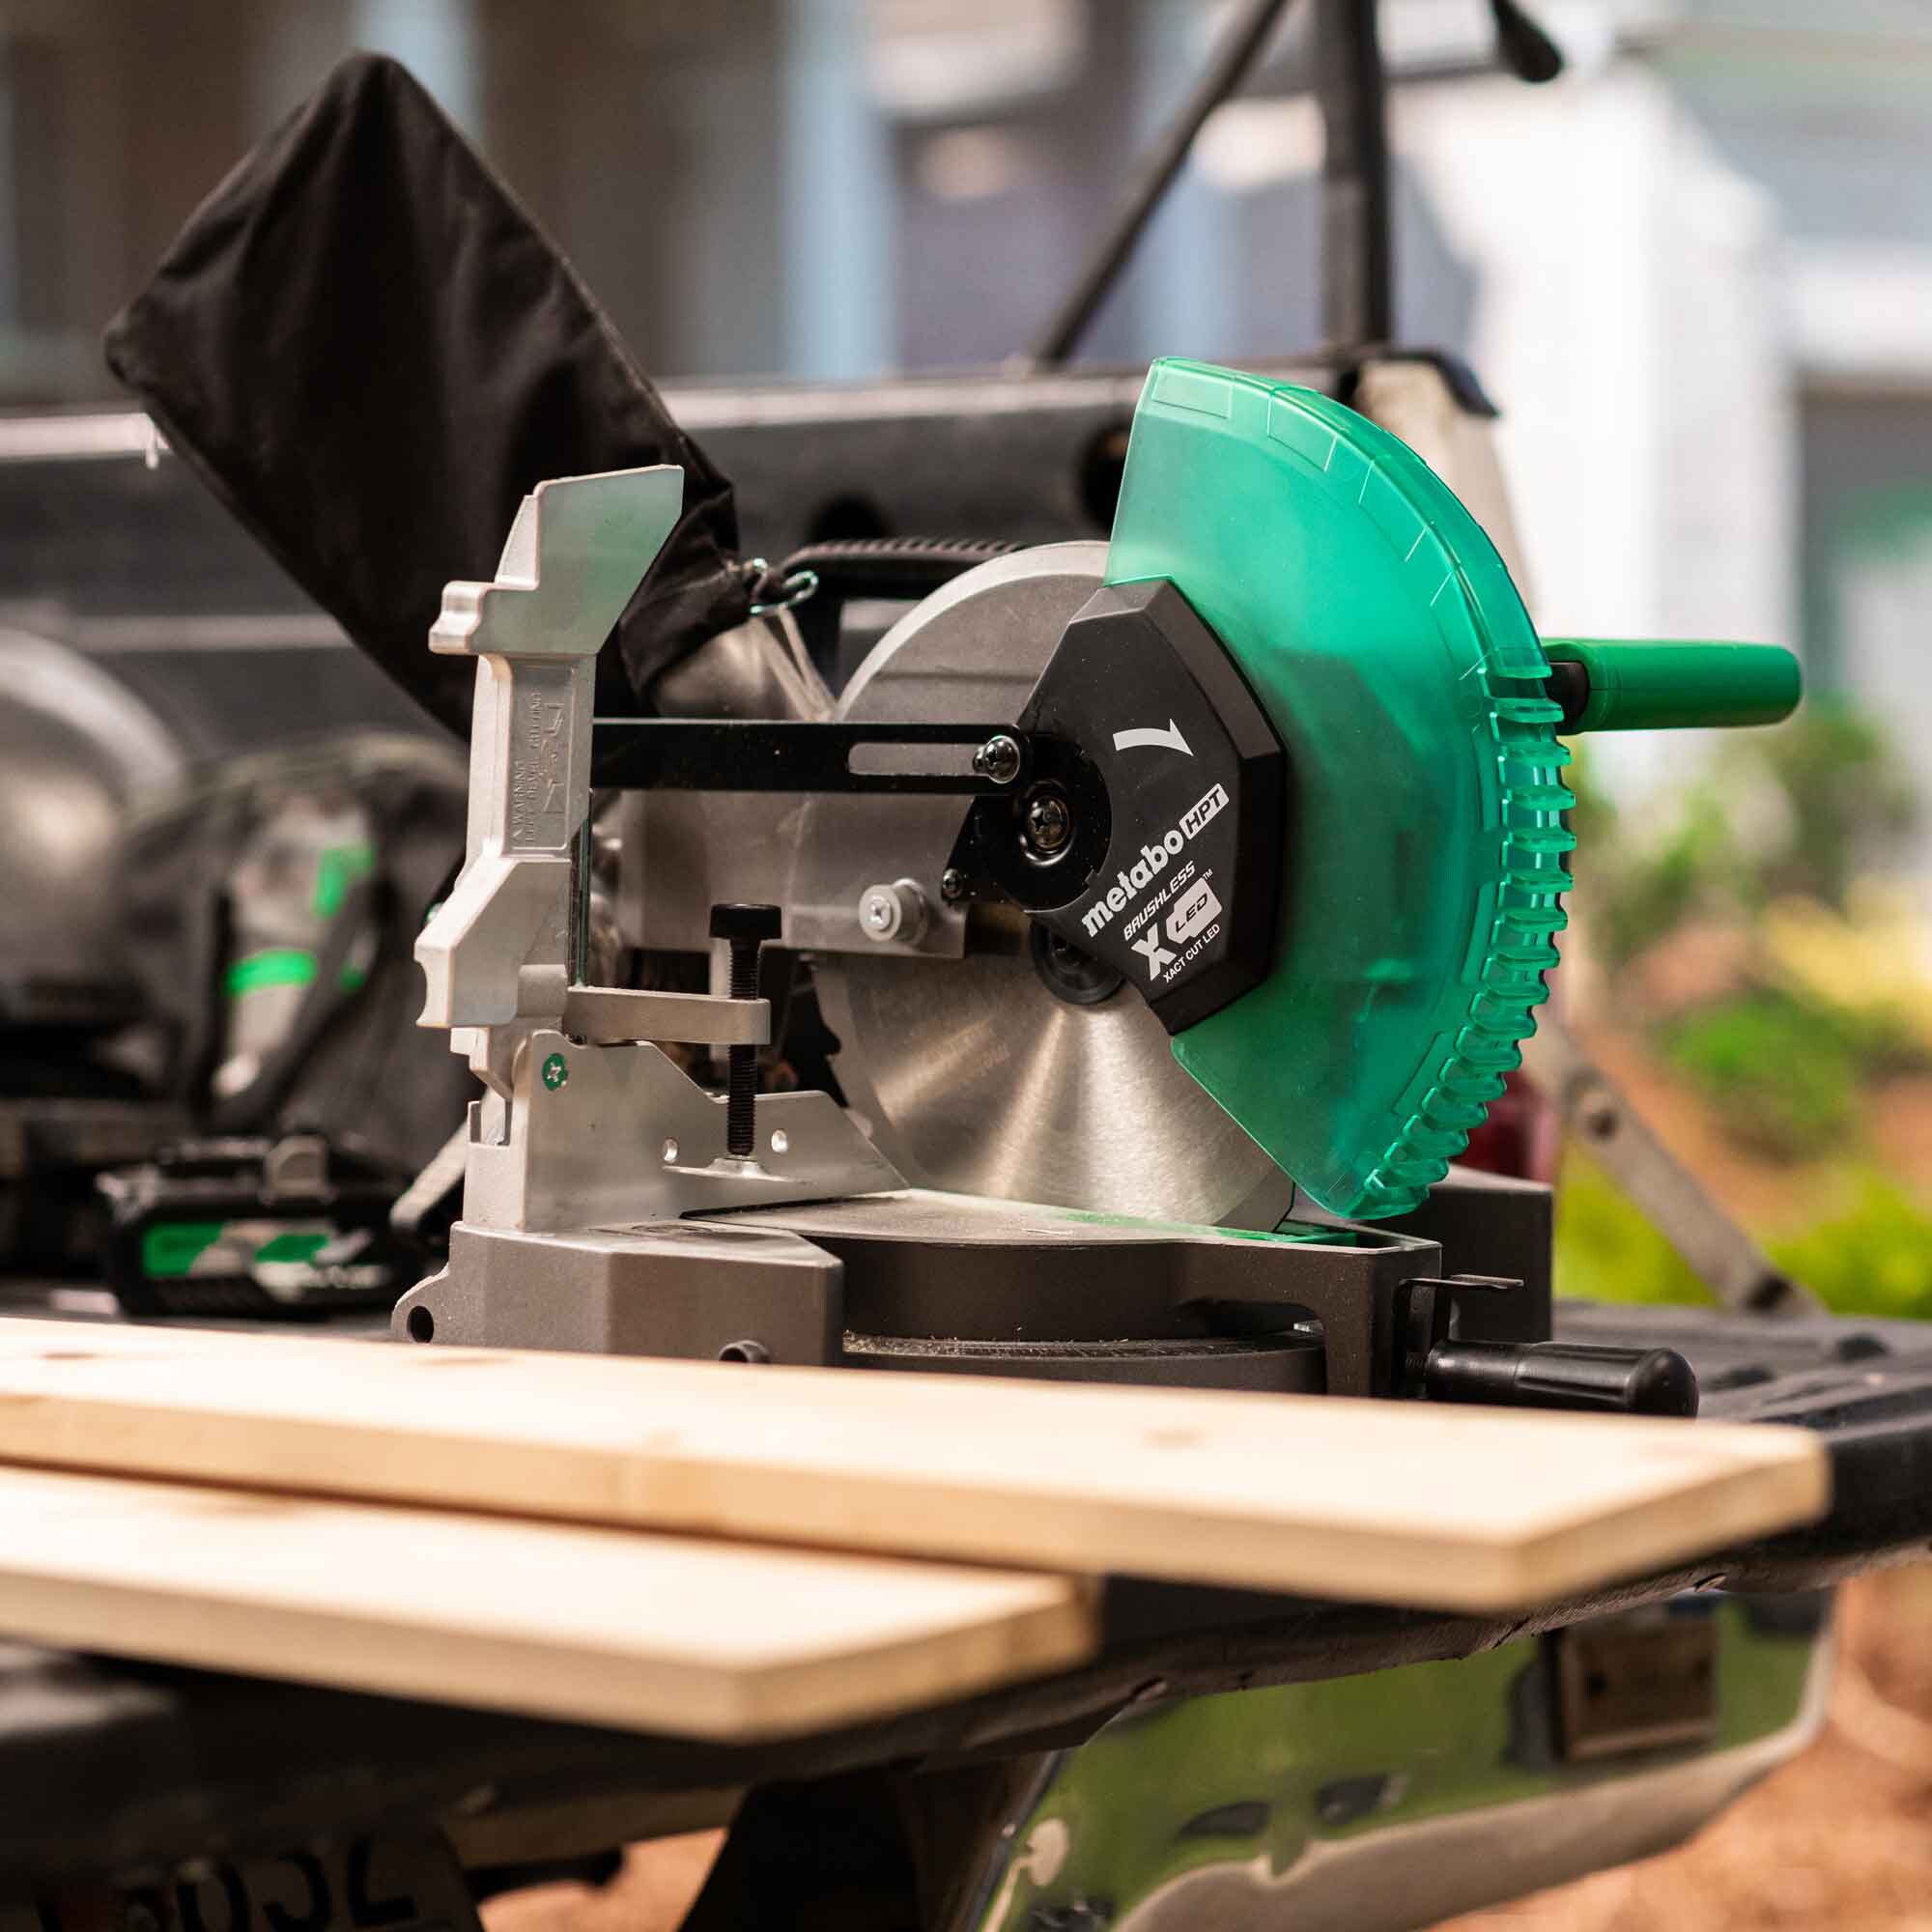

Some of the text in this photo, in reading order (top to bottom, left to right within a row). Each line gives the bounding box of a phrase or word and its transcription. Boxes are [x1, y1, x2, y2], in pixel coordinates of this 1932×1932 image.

[1081, 786, 1223, 938] metabo HPT
[1123, 860, 1196, 942] BRUSHLESS
[1175, 892, 1208, 934] LED
[1163, 923, 1221, 983] XACT CUT LED
